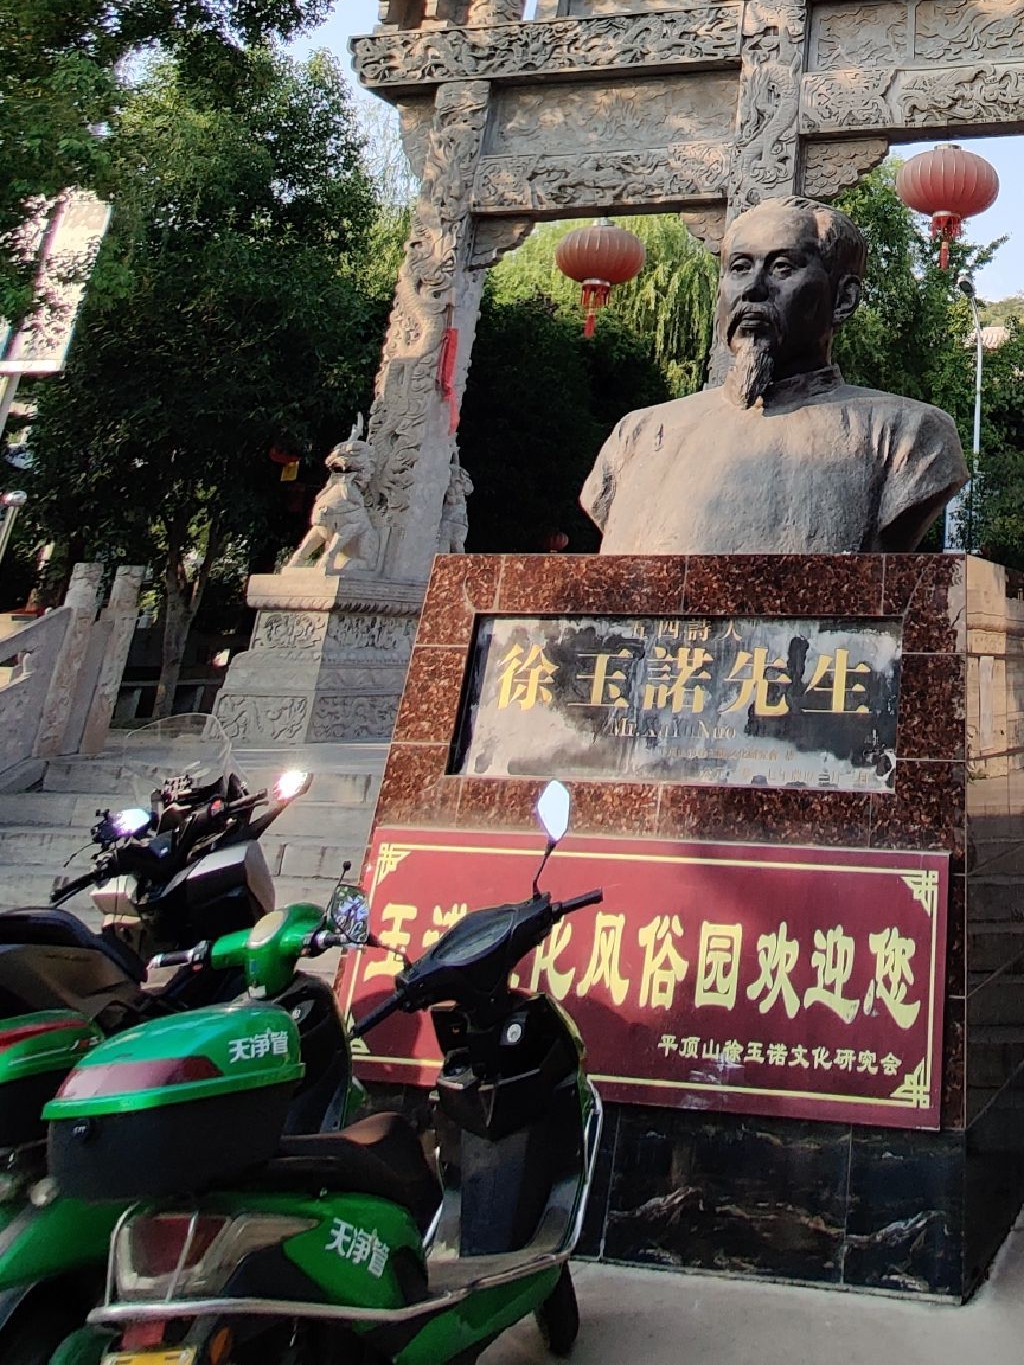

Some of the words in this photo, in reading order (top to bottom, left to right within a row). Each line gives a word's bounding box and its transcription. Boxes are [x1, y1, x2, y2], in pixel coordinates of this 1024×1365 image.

[496, 643, 872, 716] 徐玉諾先生
[364, 903, 921, 1030] 玉化风俗园欢迎您
[658, 1034, 902, 1075] 平顶山徐玉诺文化研究会
